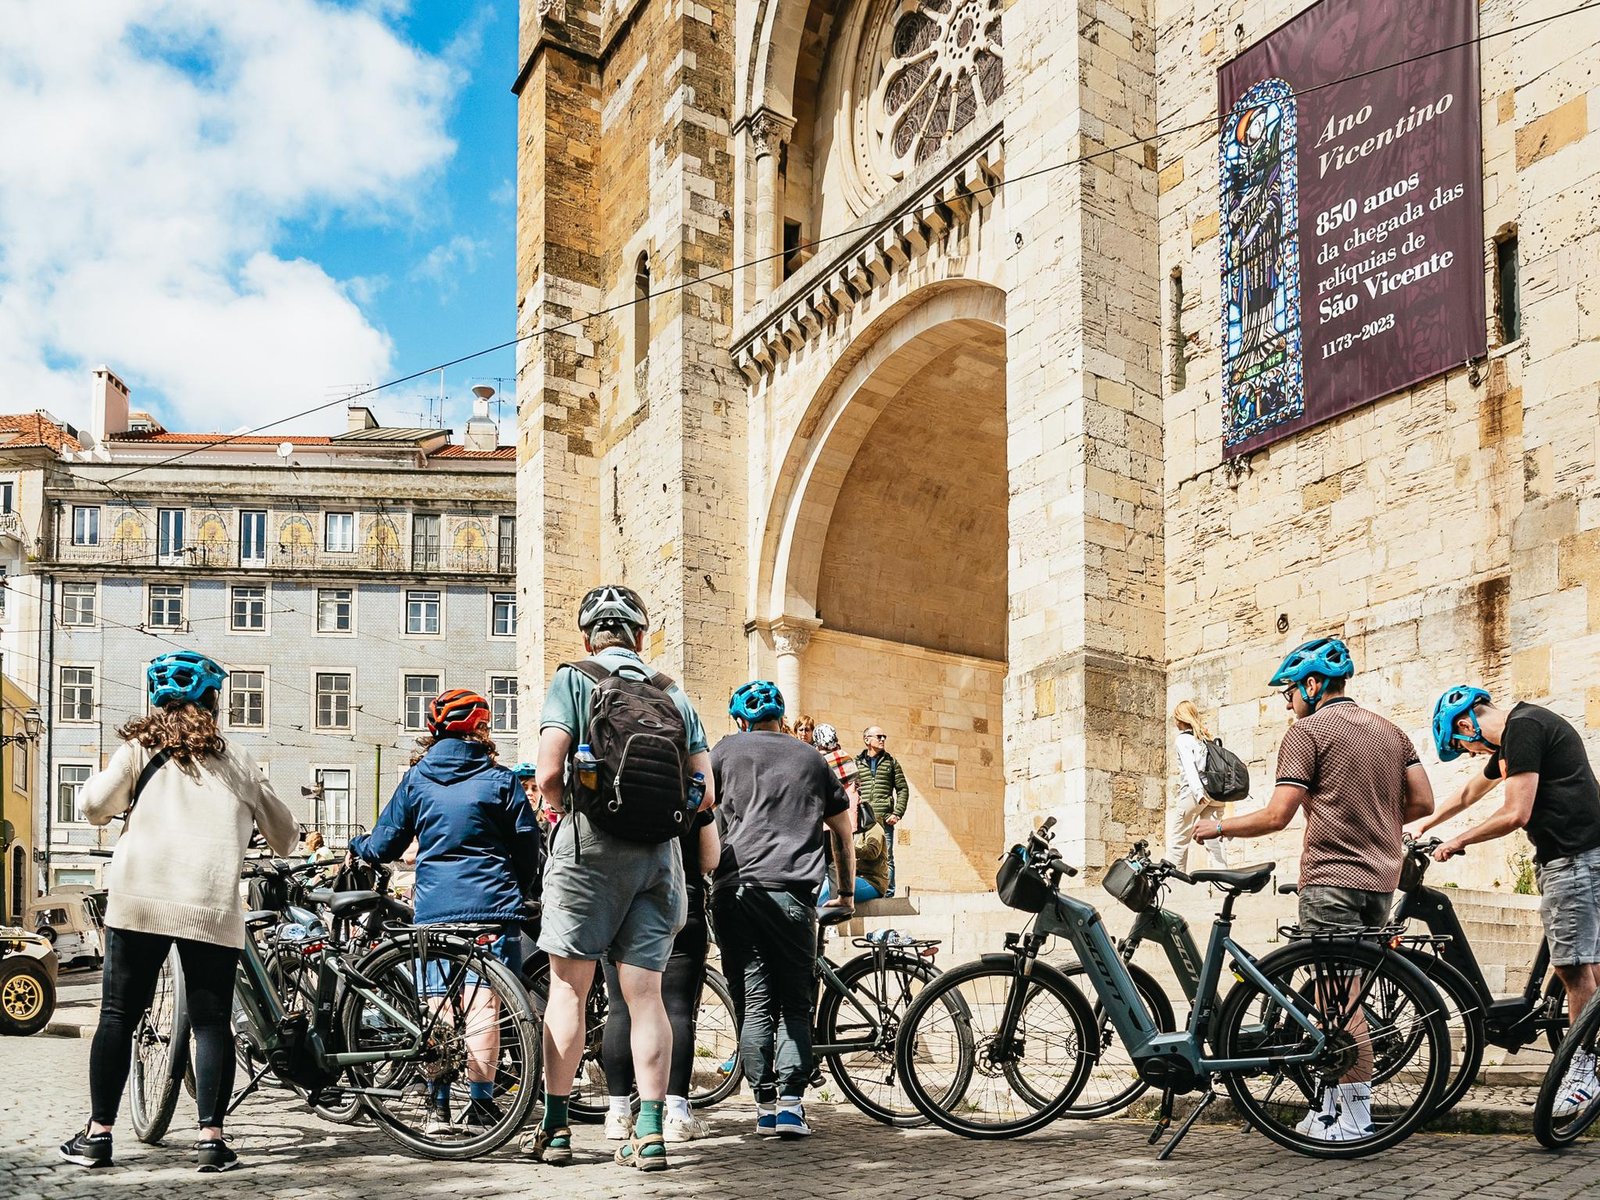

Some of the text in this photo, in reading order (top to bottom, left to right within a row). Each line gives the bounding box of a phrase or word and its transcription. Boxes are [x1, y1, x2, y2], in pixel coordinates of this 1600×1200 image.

[1313, 104, 1373, 149] Ano
[1318, 93, 1454, 180] Vicentino
[1315, 171, 1420, 237] 850 anos
[1316, 183, 1464, 265] da chegada das
[1317, 231, 1426, 296] relíquias de
[1319, 250, 1454, 325] São Vicente
[1080, 930, 1126, 1006] SCOTT
[1170, 933, 1201, 983] SCOT
